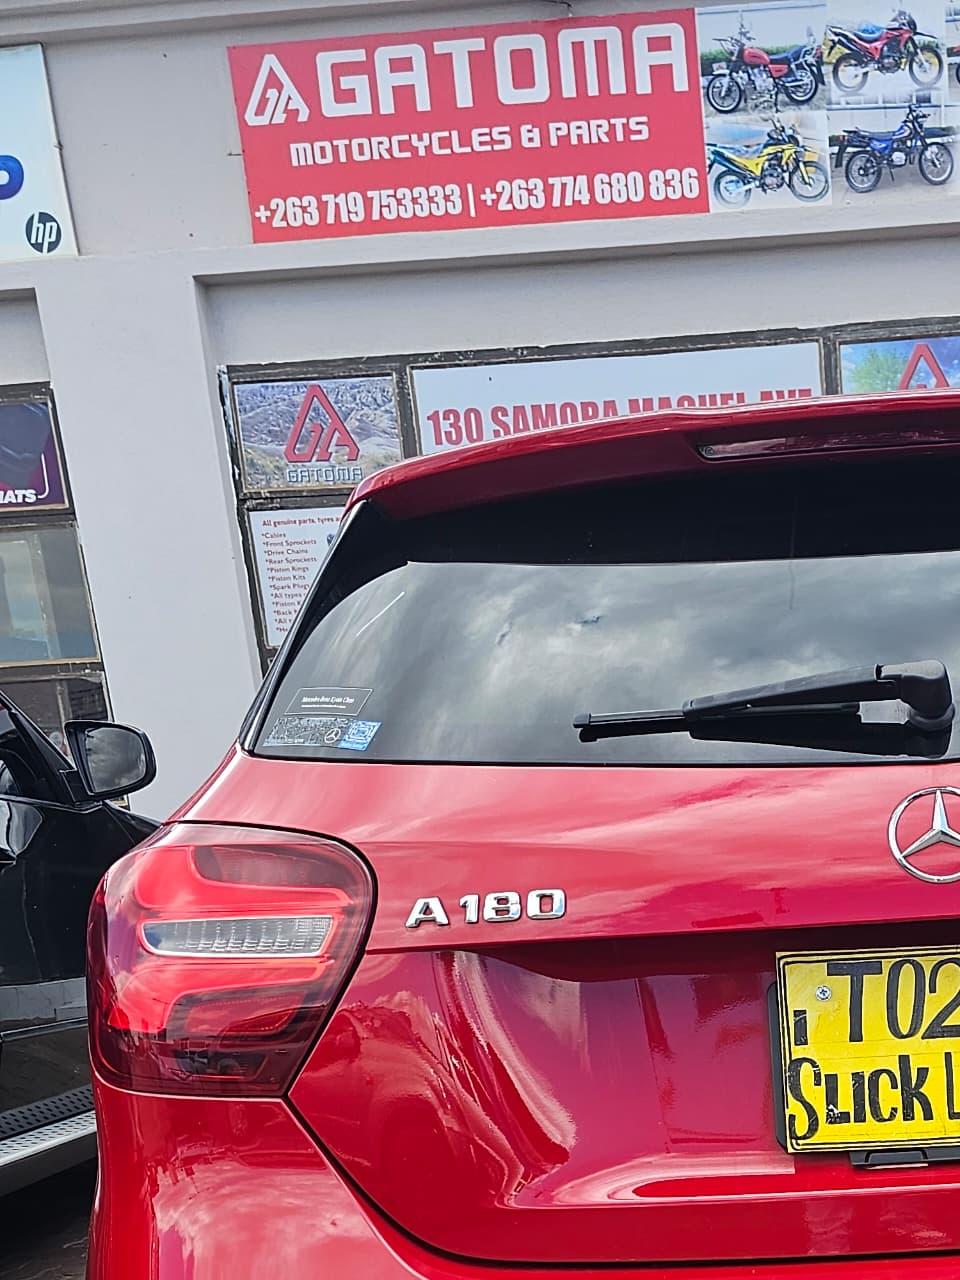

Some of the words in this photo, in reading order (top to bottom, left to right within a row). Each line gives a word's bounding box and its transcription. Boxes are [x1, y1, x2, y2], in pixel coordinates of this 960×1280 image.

[316, 22, 689, 117] GATOMA
[290, 125, 511, 167] MOTORCYCLES
[520, 123, 541, 148] &
[549, 116, 649, 147] PARTS
[255, 194, 319, 228] +263
[322, 191, 364, 224] 719
[367, 184, 462, 221] 753333
[480, 177, 545, 211] +263
[547, 174, 592, 207] 774
[594, 170, 644, 204] 680
[648, 167, 700, 199] 836
[29, 211, 60, 254] hp
[427, 407, 483, 446] 130
[286, 467, 363, 482] GATOMA
[405, 896, 449, 928] A
[459, 888, 566, 924] 180
